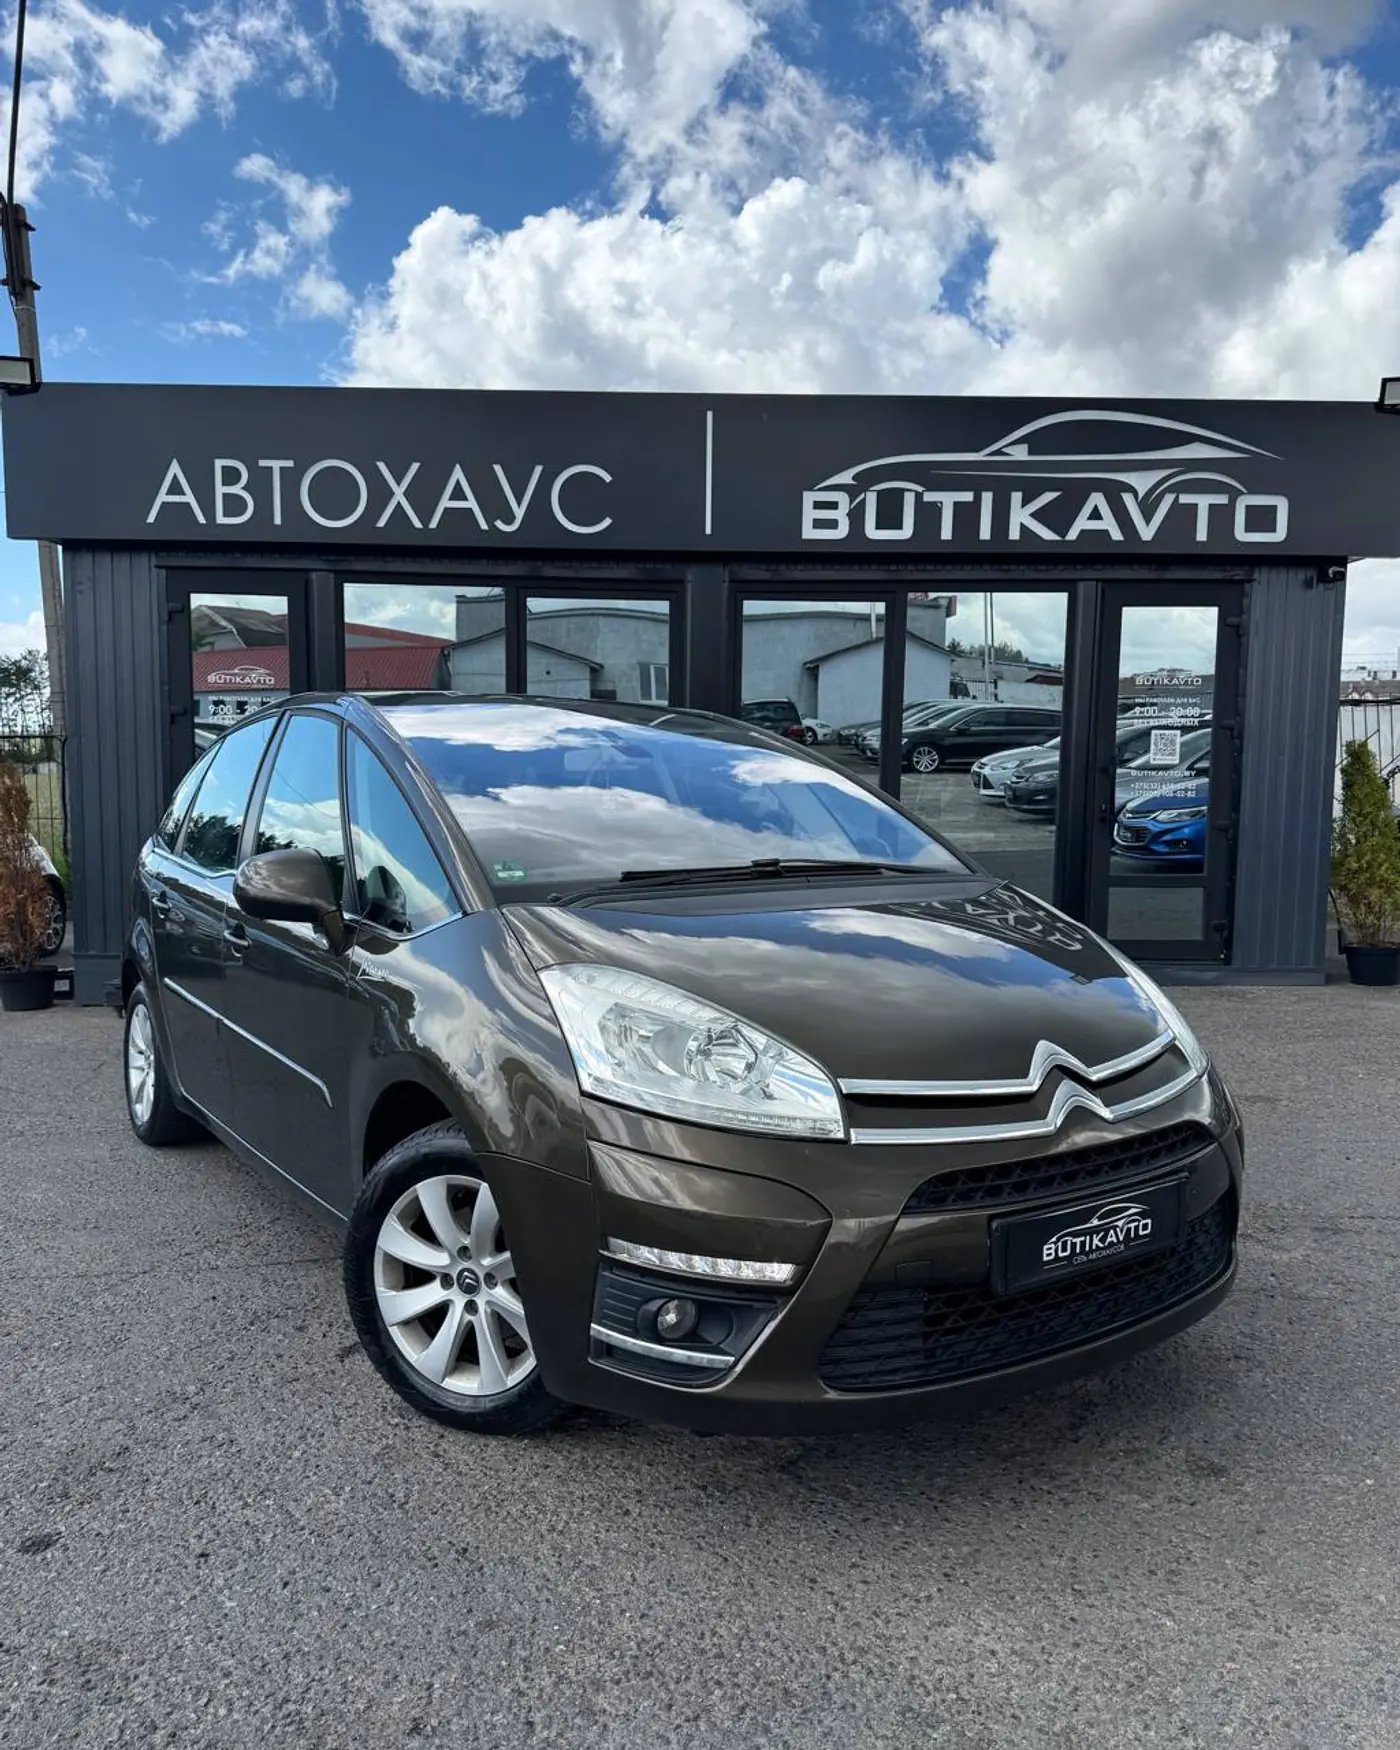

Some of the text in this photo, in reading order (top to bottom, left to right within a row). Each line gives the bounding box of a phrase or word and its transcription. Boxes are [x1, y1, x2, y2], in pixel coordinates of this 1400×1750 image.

[146, 457, 613, 535] АВТОХАУС
[801, 490, 1289, 543] BUTIKAVTO
[207, 675, 275, 684] BUTIKAVTO
[1135, 677, 1202, 685] BUTIKAVTO
[208, 705, 233, 715] 9:00
[1042, 1218, 1152, 1262] BUTIKAVTO
